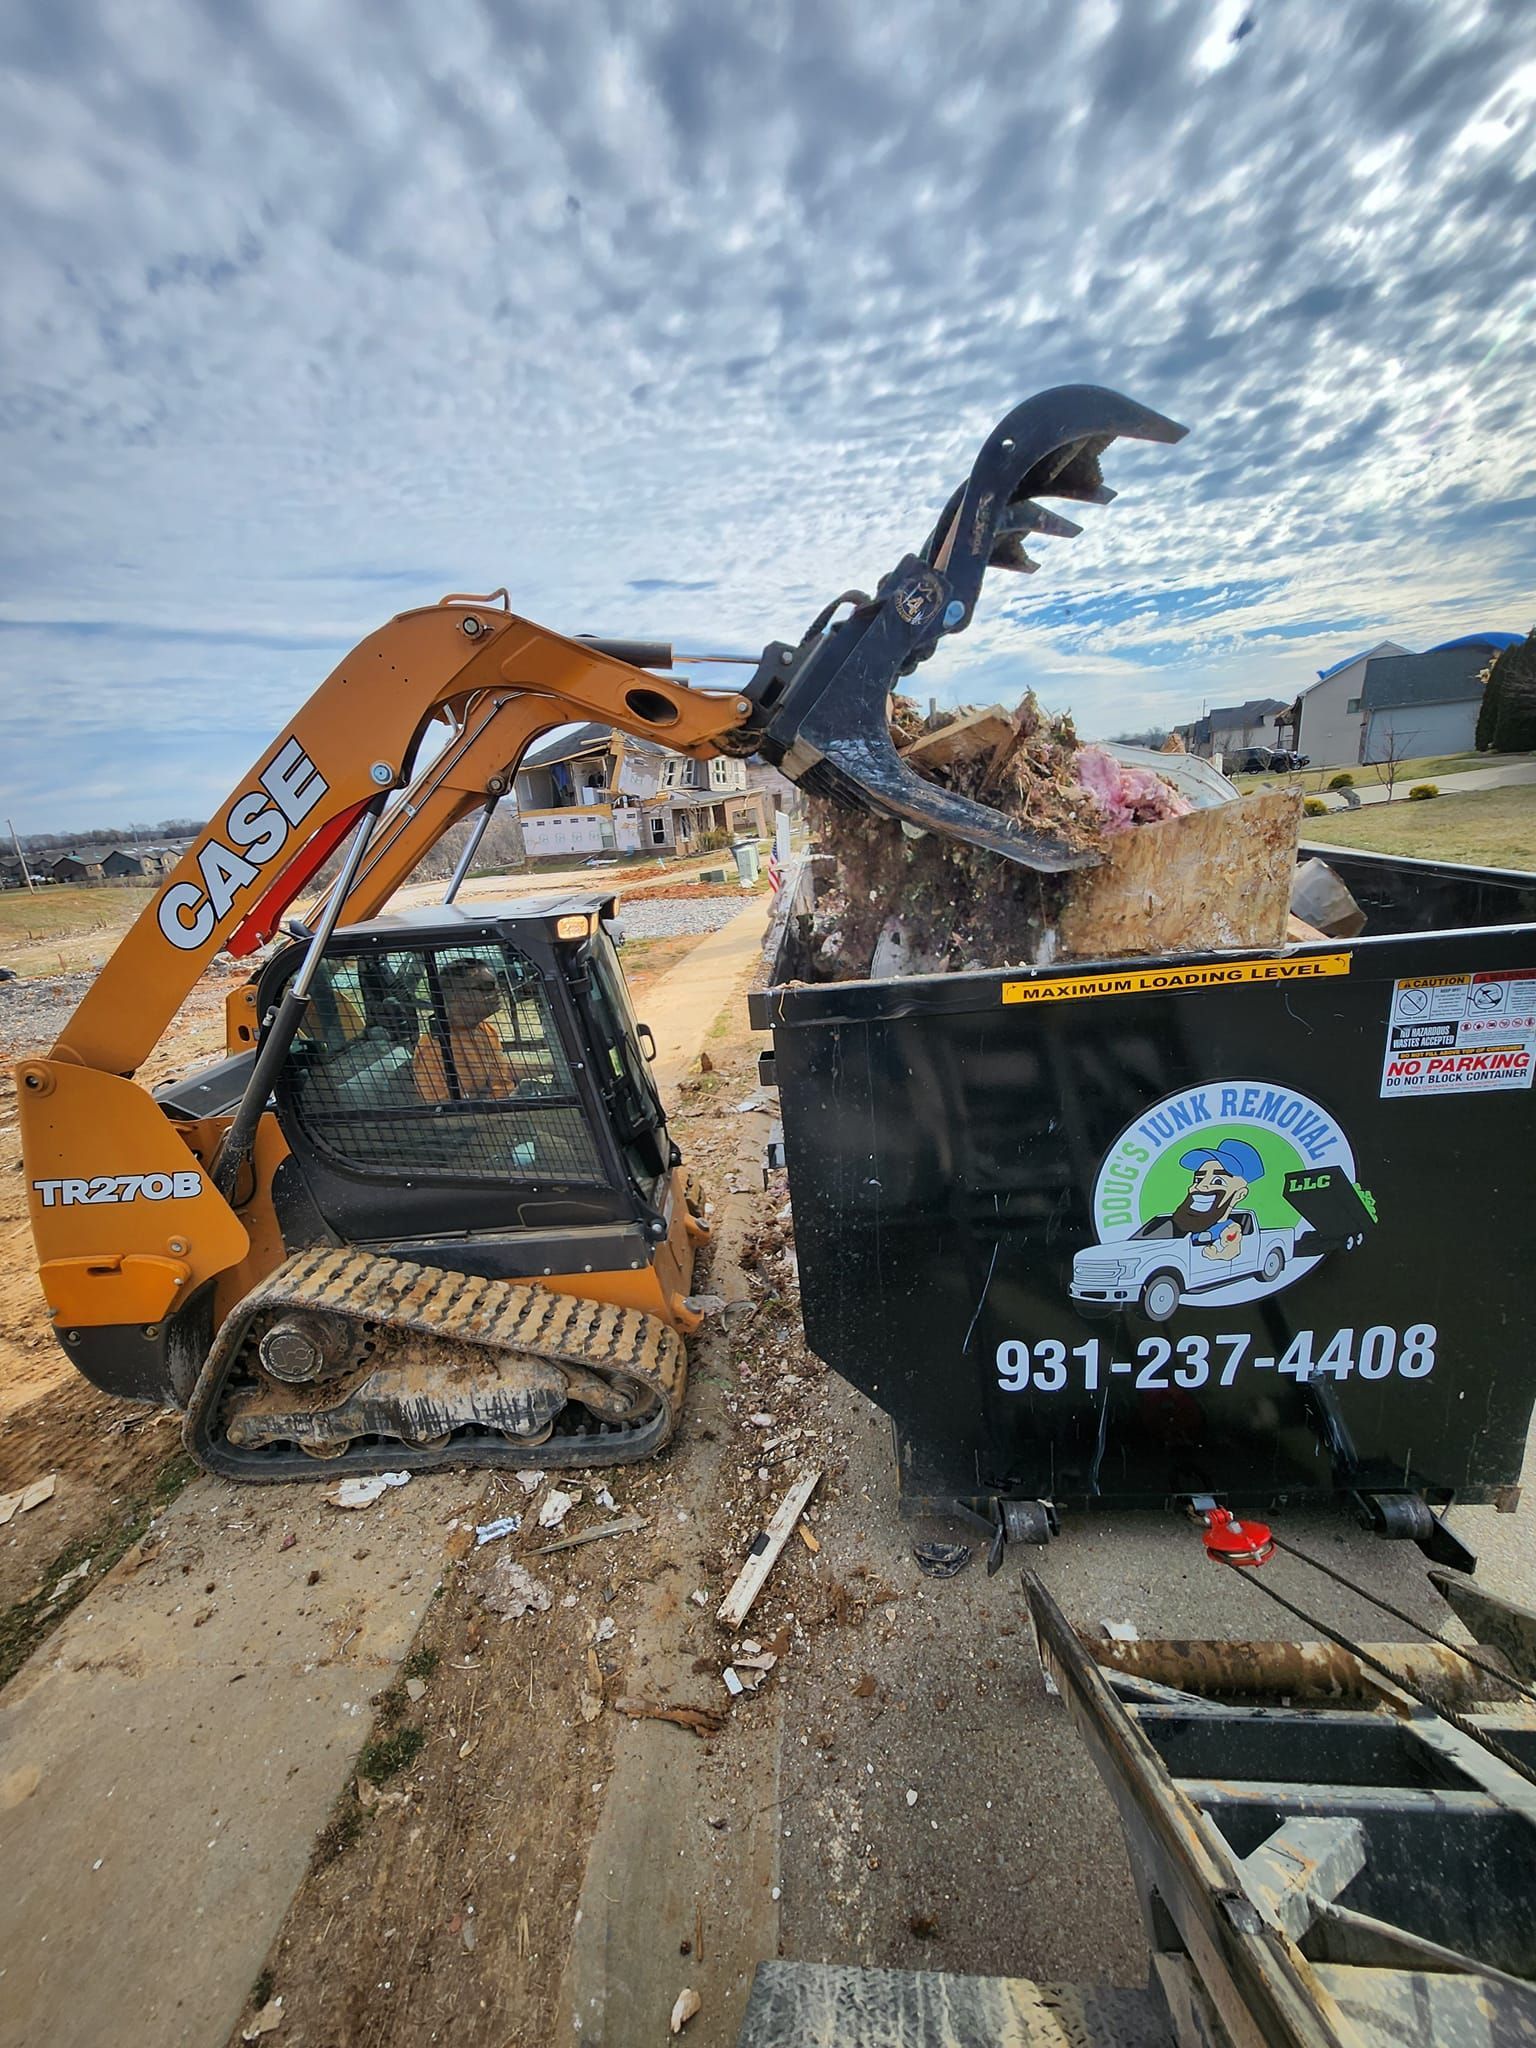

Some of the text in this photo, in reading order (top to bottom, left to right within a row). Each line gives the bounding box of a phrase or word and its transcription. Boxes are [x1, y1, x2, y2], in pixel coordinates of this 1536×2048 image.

[157, 734, 330, 950] CASE
[1022, 963, 1326, 1000] MAXIMUM LOADING LEVEL
[1413, 976, 1465, 988] CAUTION
[1393, 1037, 1420, 1049] WASTES
[1420, 1035, 1455, 1047] ACCEPTED
[1411, 1025, 1451, 1038] HAZARDOUS
[1387, 1052, 1531, 1077] NO PARKING
[1386, 1077, 1400, 1087] DO
[1404, 1075, 1425, 1086] NOT
[1428, 1072, 1463, 1084] BLOCK
[1466, 1068, 1528, 1081] CONTAINER
[1102, 1088, 1338, 1229] DOUG'S JUNK REMOVAL
[33, 1170, 203, 1207] TR270B
[1288, 1174, 1331, 1193] LLC
[996, 1322, 1437, 1392] 931-237-4408
